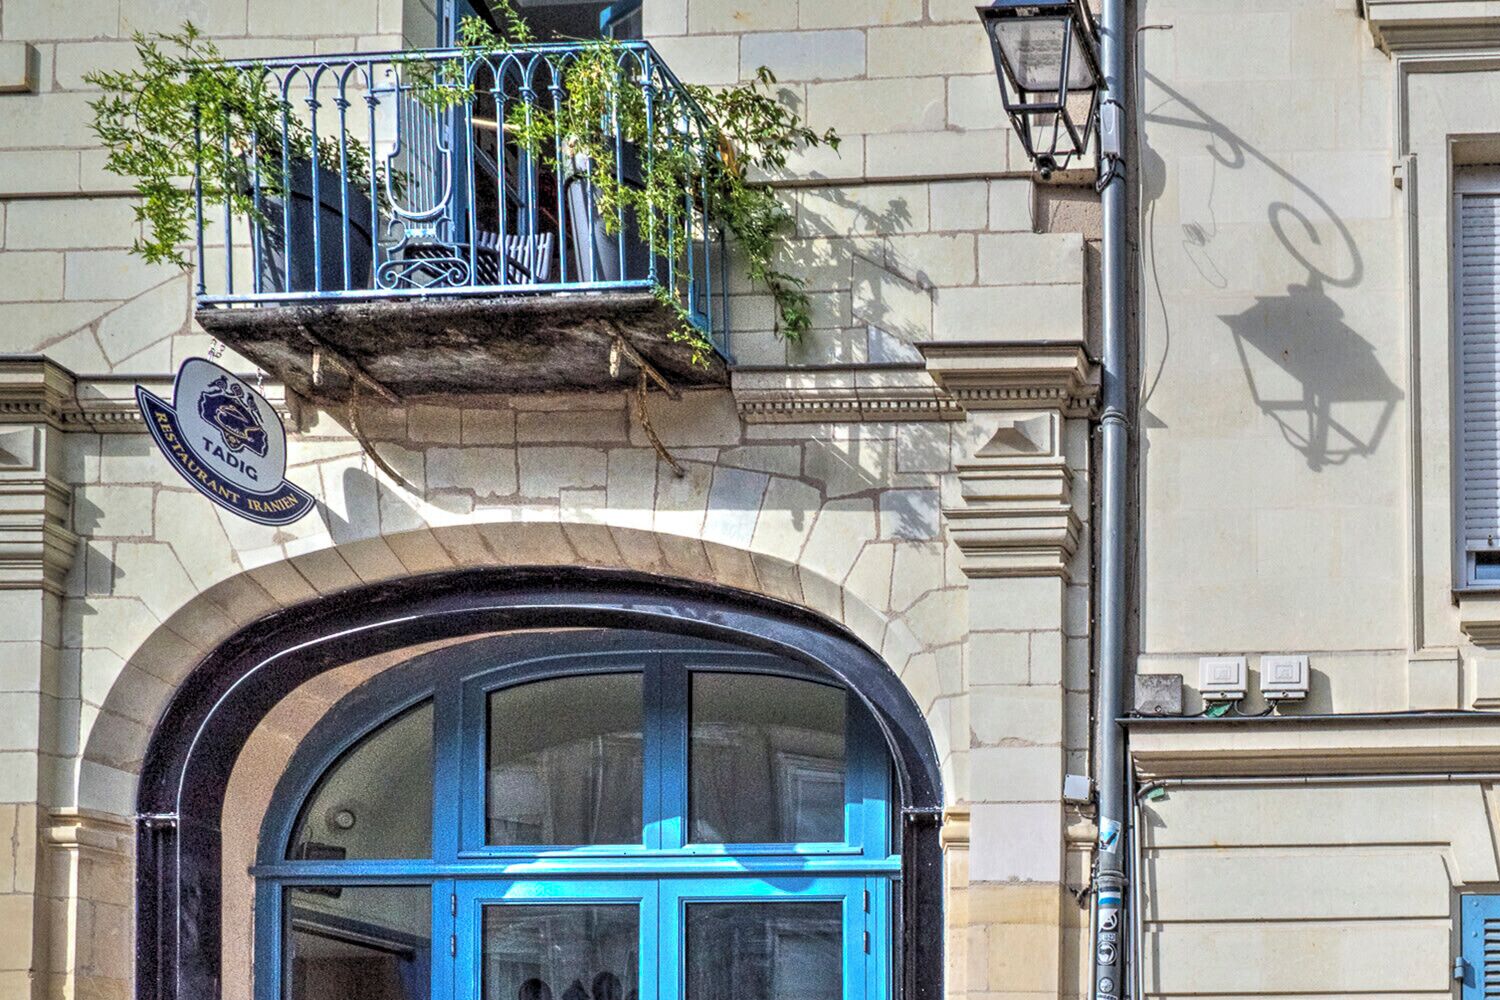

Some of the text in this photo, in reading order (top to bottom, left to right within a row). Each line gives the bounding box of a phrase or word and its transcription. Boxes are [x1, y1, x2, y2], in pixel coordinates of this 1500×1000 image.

[154, 410, 299, 513] RESTAURANT IRANIEN
[202, 436, 259, 482] TADIG
